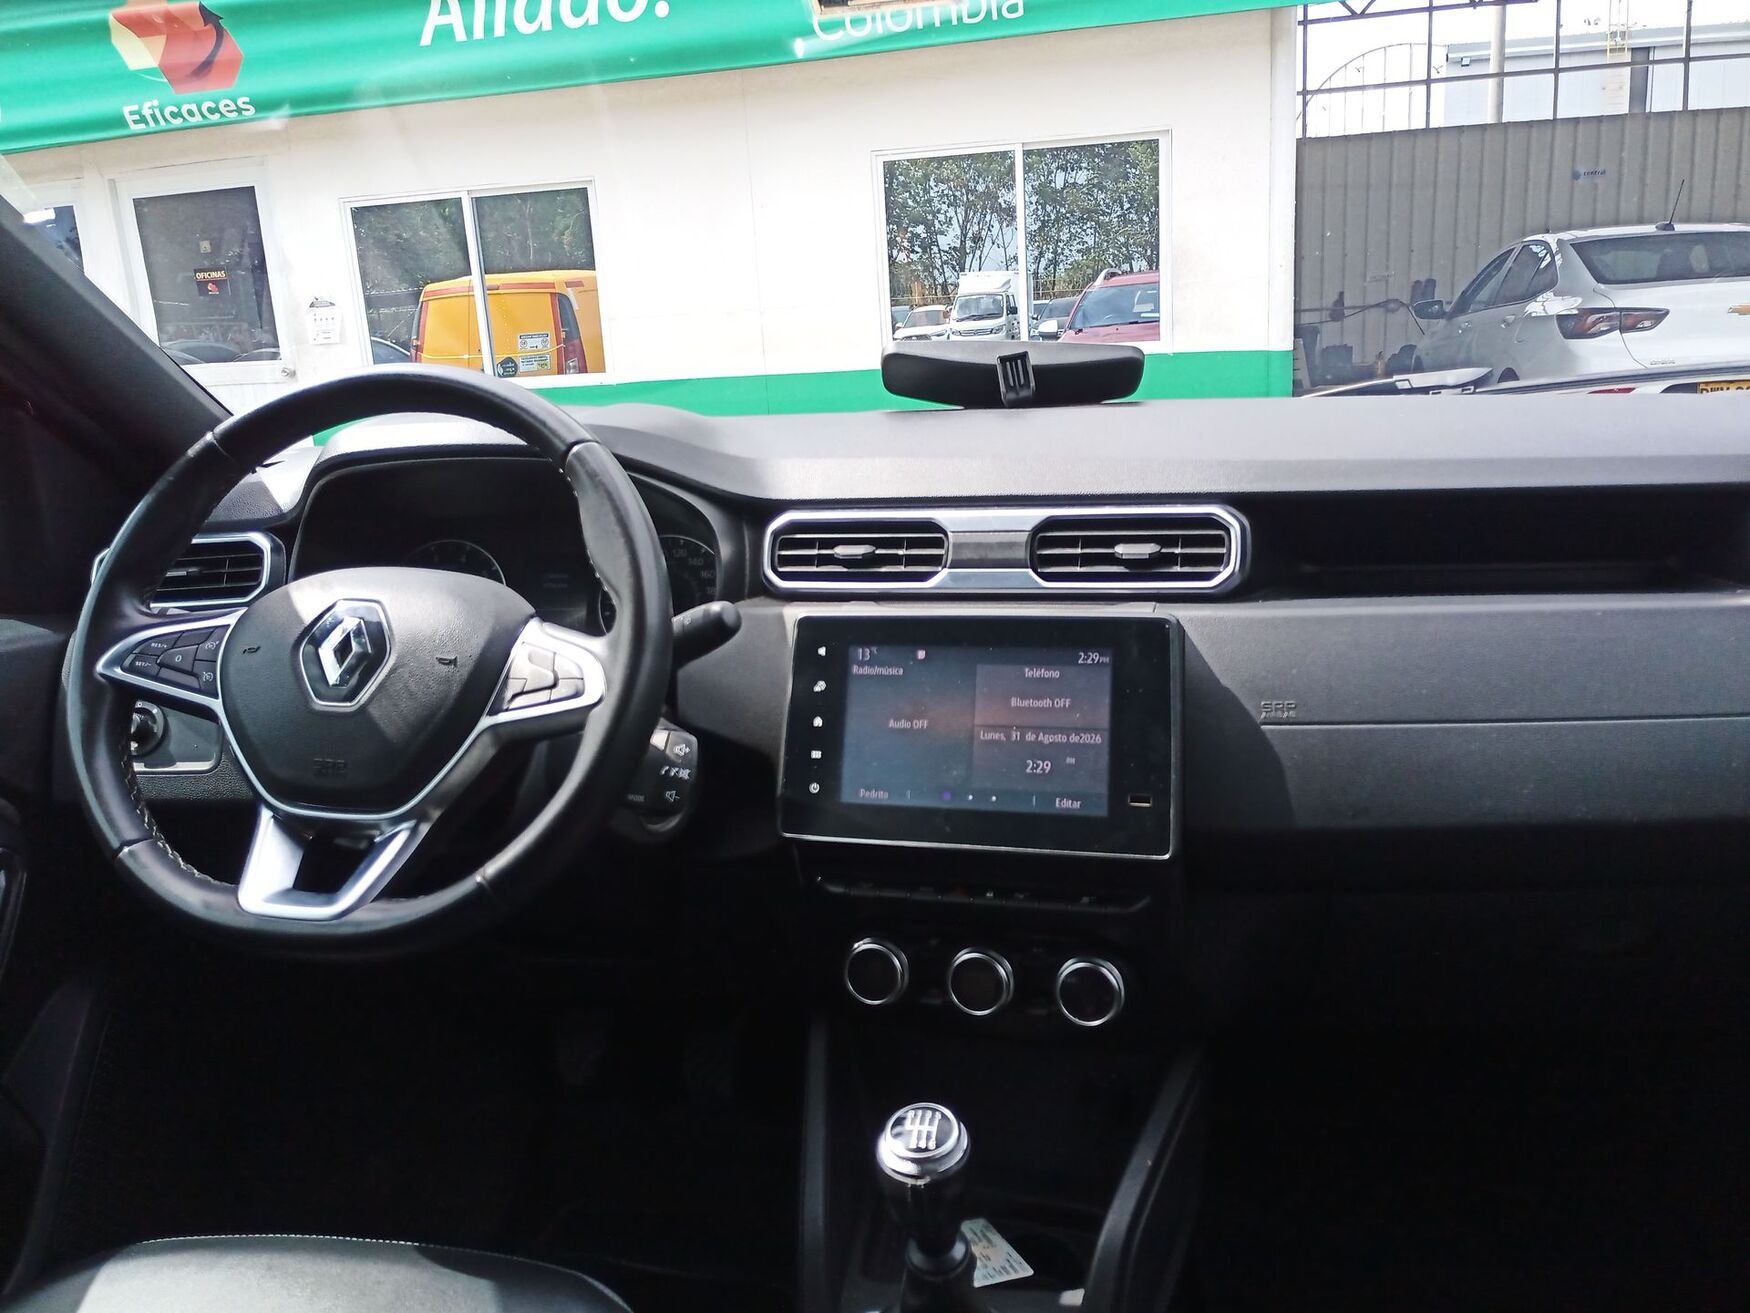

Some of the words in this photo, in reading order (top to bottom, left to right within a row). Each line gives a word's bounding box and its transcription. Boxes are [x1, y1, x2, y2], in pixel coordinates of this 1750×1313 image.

[122, 96, 256, 130] Eficaces
[195, 270, 226, 279] OFICINAS
[857, 647, 871, 661] 13
[852, 664, 904, 676] Radio/música
[1024, 667, 1060, 679] Teléfono
[1010, 696, 1053, 708] Bluetooth
[1054, 698, 1071, 709] OFF
[888, 718, 912, 729] Audio
[912, 719, 929, 729] OFF
[980, 730, 1006, 741] Lunes,
[1011, 731, 1021, 741] 31
[1025, 731, 1036, 742] de
[1038, 732, 1067, 744] Agosto
[1025, 759, 1052, 774] 2:29
[860, 788, 889, 799] Pedrito
[1055, 797, 1081, 809] Editar
